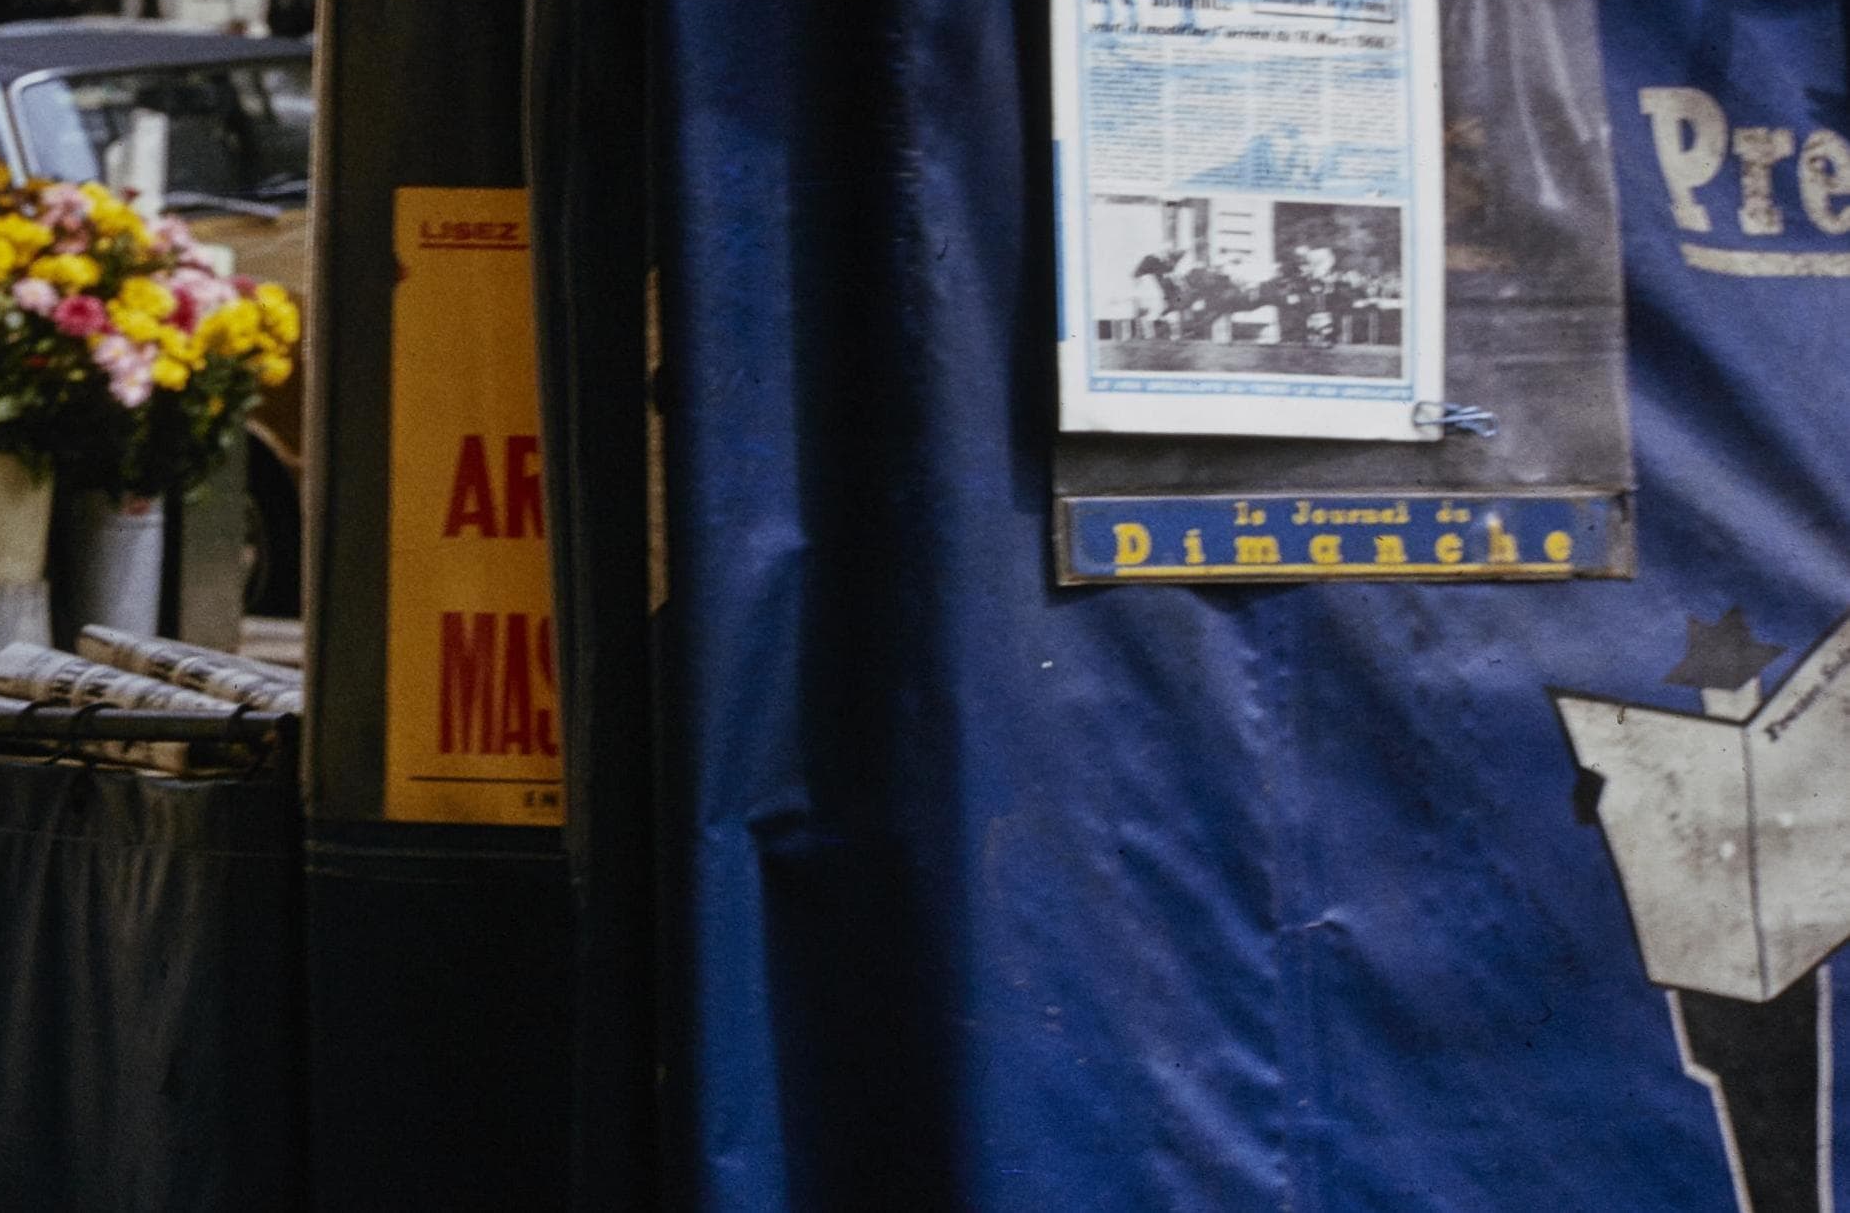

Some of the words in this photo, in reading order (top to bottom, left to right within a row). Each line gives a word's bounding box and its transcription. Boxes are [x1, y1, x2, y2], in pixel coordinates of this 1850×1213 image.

[1638, 87, 1850, 235] Pre
[1291, 499, 1411, 526] Journal
[1435, 499, 1471, 524] du
[1113, 513, 1573, 566] Dimanche
